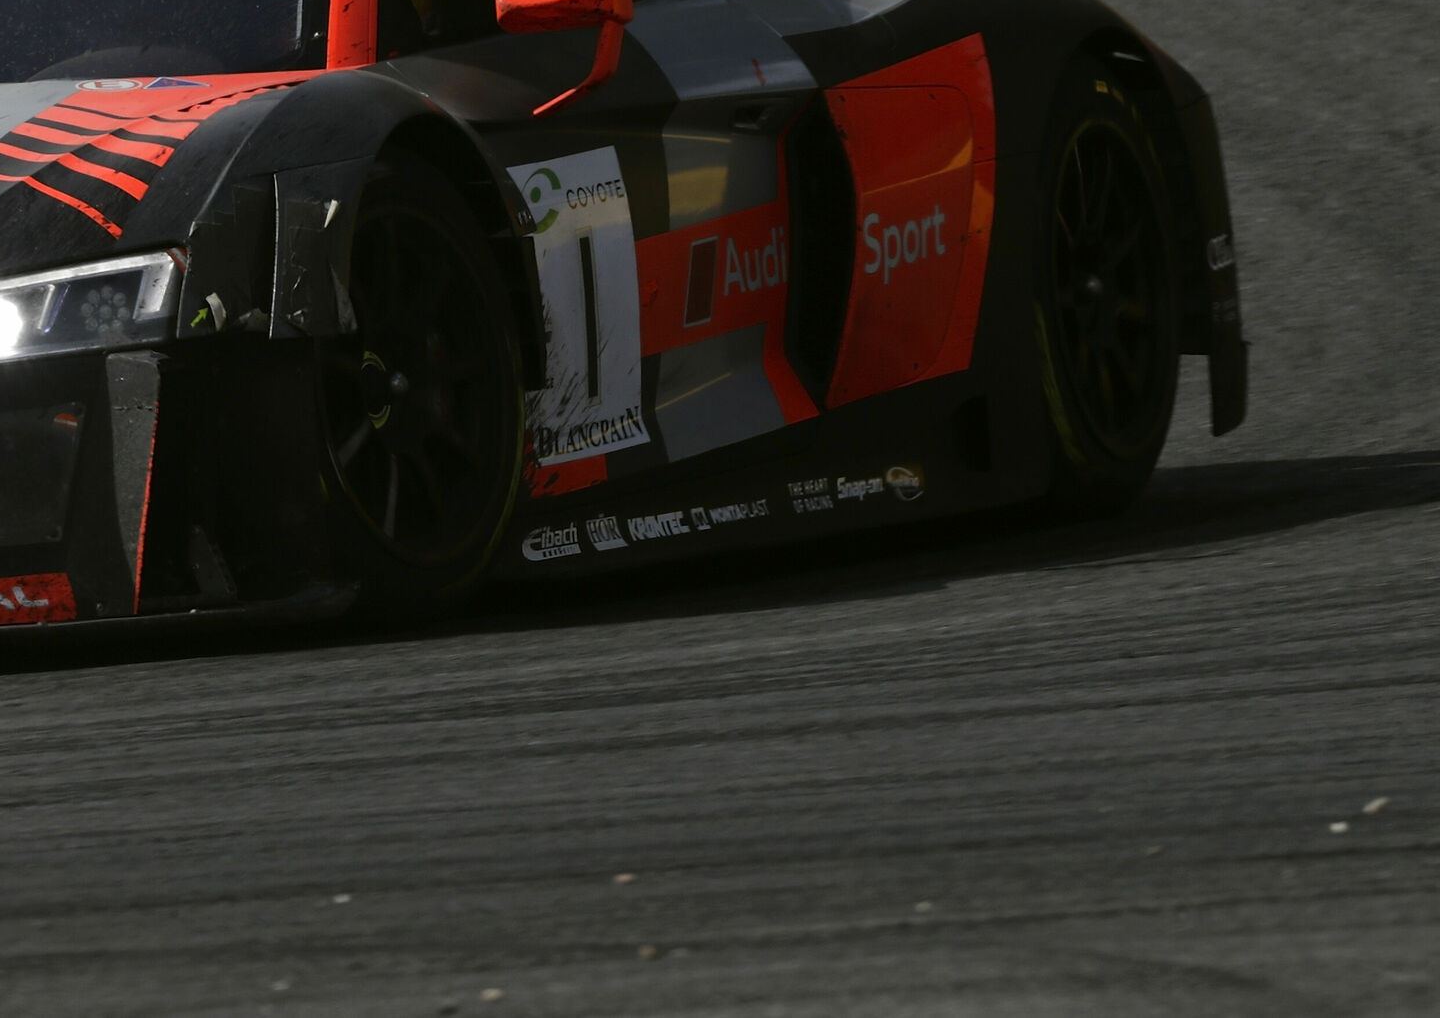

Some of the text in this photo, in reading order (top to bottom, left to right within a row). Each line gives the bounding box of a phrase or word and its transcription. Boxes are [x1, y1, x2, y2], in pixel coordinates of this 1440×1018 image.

[566, 179, 624, 209] COYOTE
[723, 204, 946, 297] Audi Sport
[538, 405, 643, 458] BLANCPAIN
[521, 521, 582, 562] Eibach
[627, 510, 691, 542] KRONTEC
